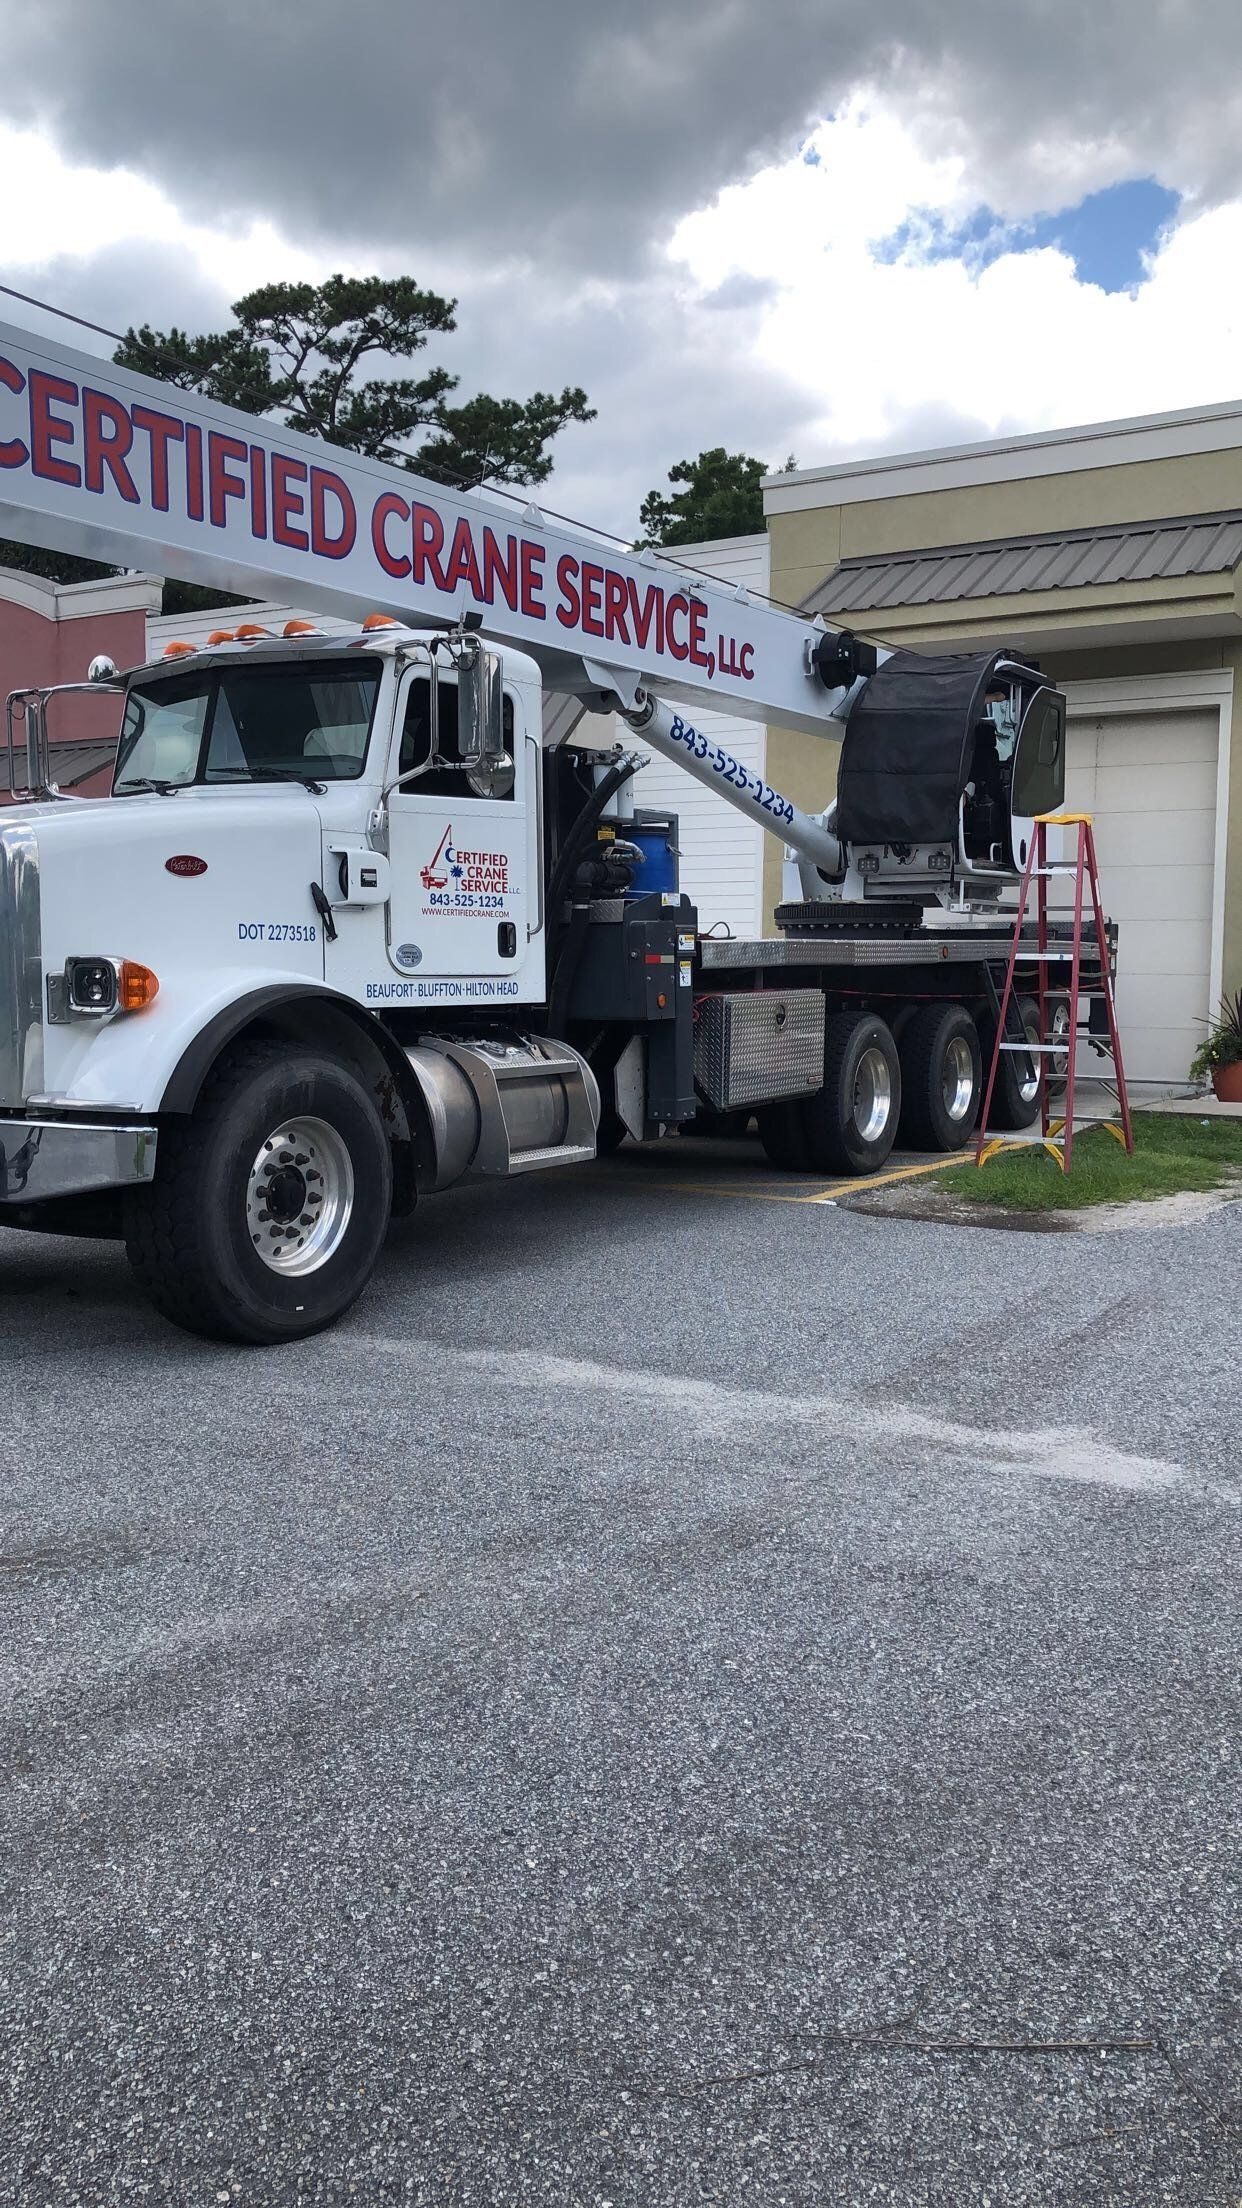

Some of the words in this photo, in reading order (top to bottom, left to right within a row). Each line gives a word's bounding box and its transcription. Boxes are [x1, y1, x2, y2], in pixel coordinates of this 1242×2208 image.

[371, 491, 546, 621] CRANE
[555, 554, 715, 681] SERVICE,
[718, 634, 755, 681] LLC
[670, 715, 794, 825] 843-525-1234
[445, 847, 508, 867] CERTIFIED
[467, 866, 508, 881] CRANE
[461, 879, 508, 894] SERVICE
[429, 893, 504, 908] 843-525-1234
[421, 907, 510, 918] WWW.CERTIFIEDCRANE.COM
[238, 923, 265, 941] DOT
[268, 924, 316, 942] 2273518
[497, 982, 519, 996] HEAD
